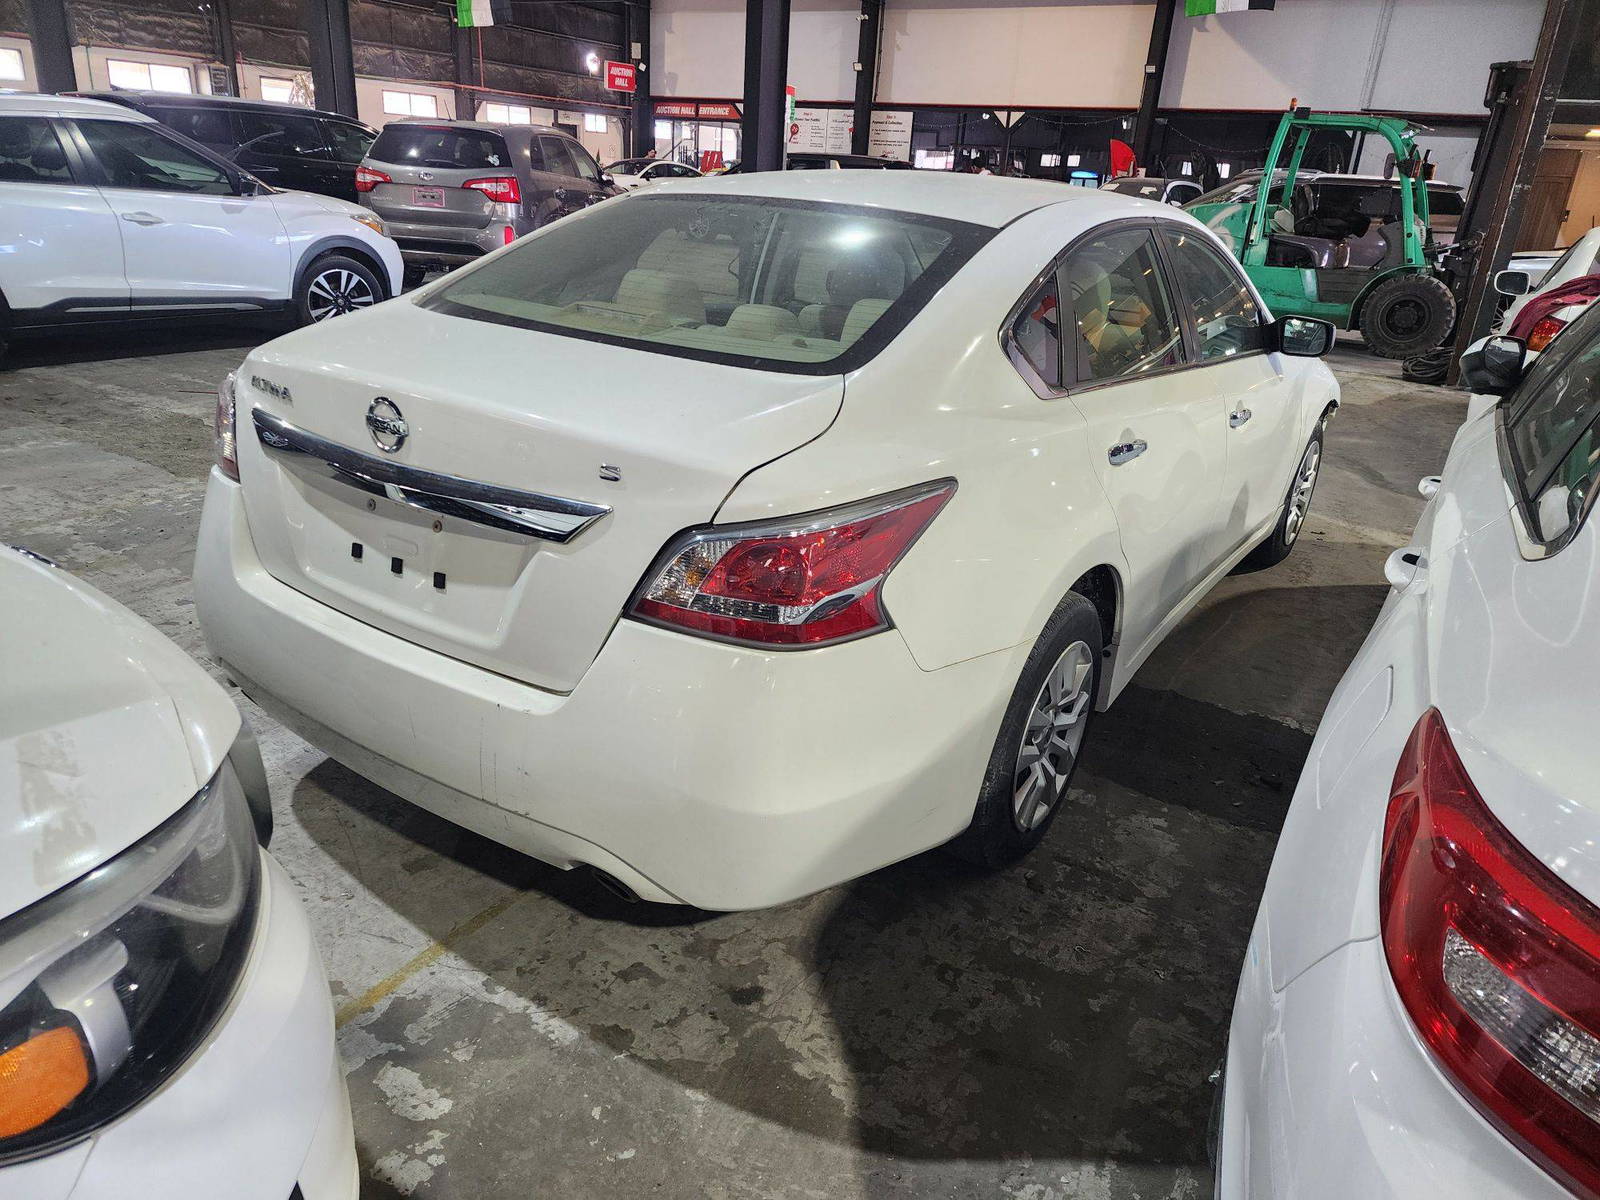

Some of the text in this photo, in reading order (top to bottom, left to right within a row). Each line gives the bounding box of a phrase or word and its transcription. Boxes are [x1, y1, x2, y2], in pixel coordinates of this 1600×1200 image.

[610, 66, 633, 77] AUCTION
[614, 77, 629, 87] HALL
[656, 106, 730, 116] AUCTION HALL ENTRANCE
[250, 375, 292, 401] ALTIMA
[367, 414, 403, 435] NISSAN
[599, 463, 622, 483] S
